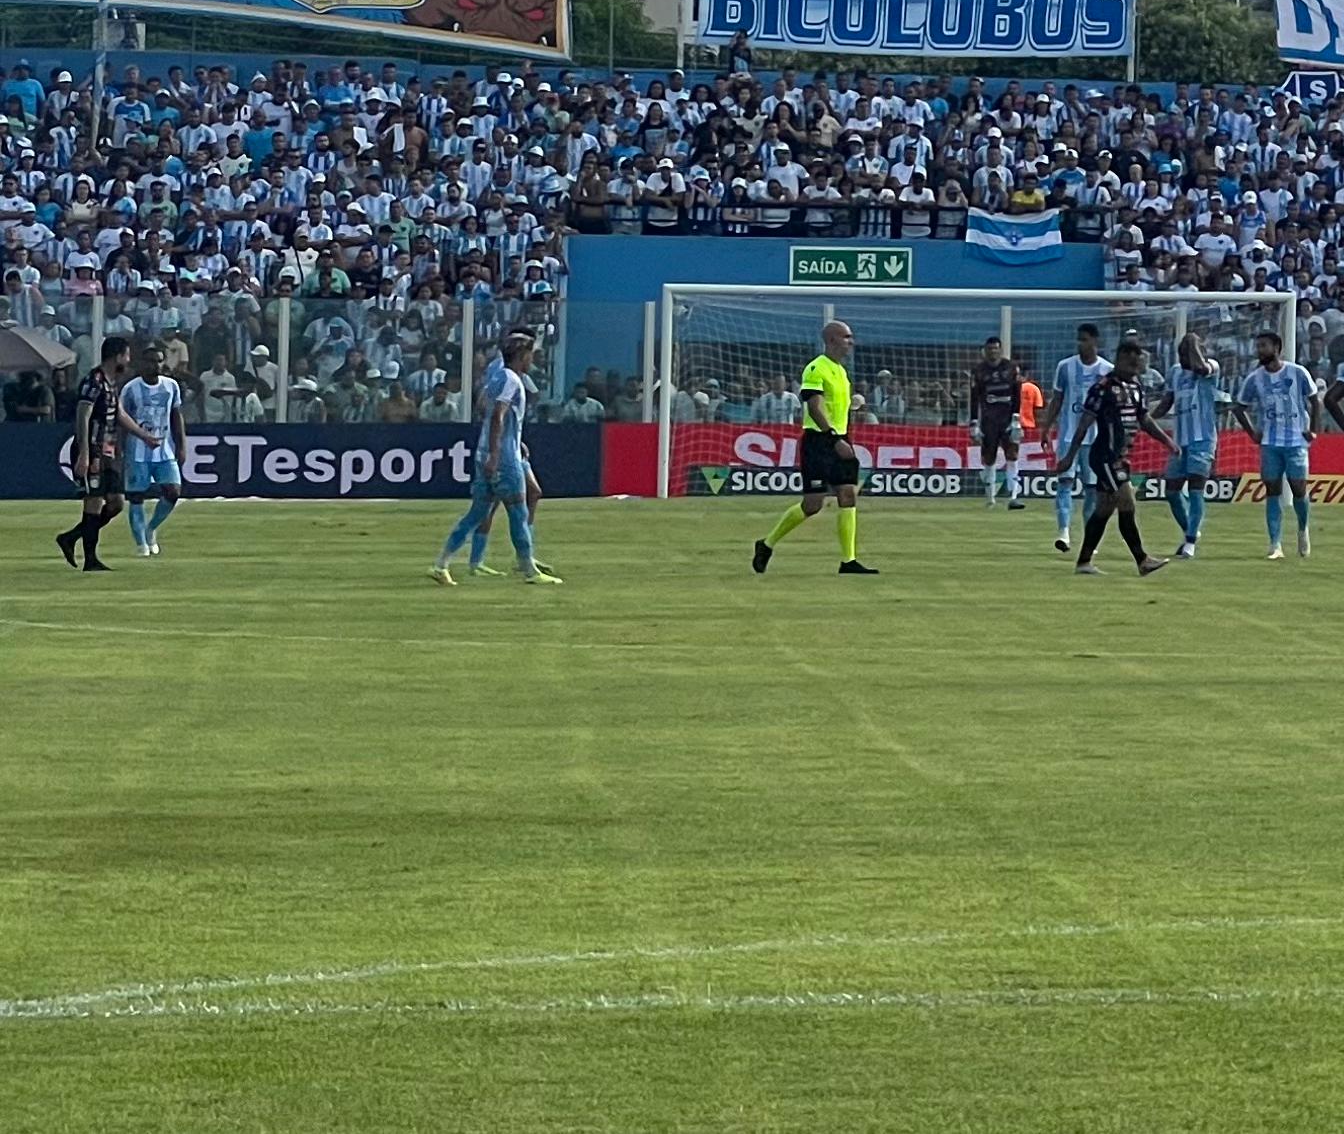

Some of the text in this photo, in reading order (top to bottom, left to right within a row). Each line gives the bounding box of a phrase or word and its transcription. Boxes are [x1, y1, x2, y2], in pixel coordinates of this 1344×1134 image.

[798, 257, 848, 275] SAÍDA
[182, 435, 472, 494] ETesport
[731, 470, 804, 493] SICOO
[870, 473, 961, 495] SICOOB
[1145, 478, 1234, 499] SIOB
